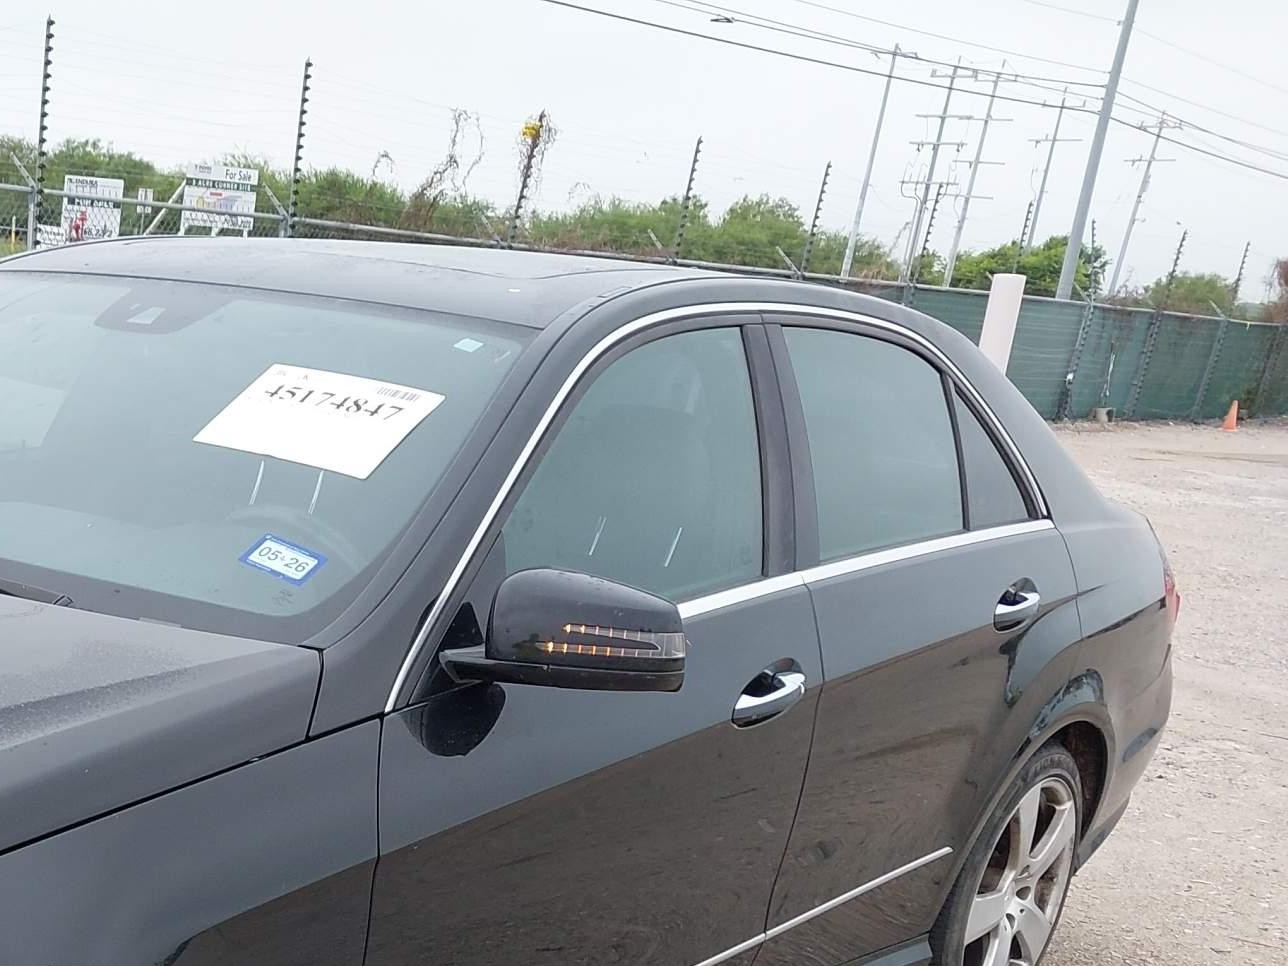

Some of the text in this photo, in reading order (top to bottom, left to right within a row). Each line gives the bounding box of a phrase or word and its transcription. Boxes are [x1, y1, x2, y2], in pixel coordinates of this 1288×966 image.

[264, 385, 404, 420] 45174847
[258, 546, 309, 572] 05 26
